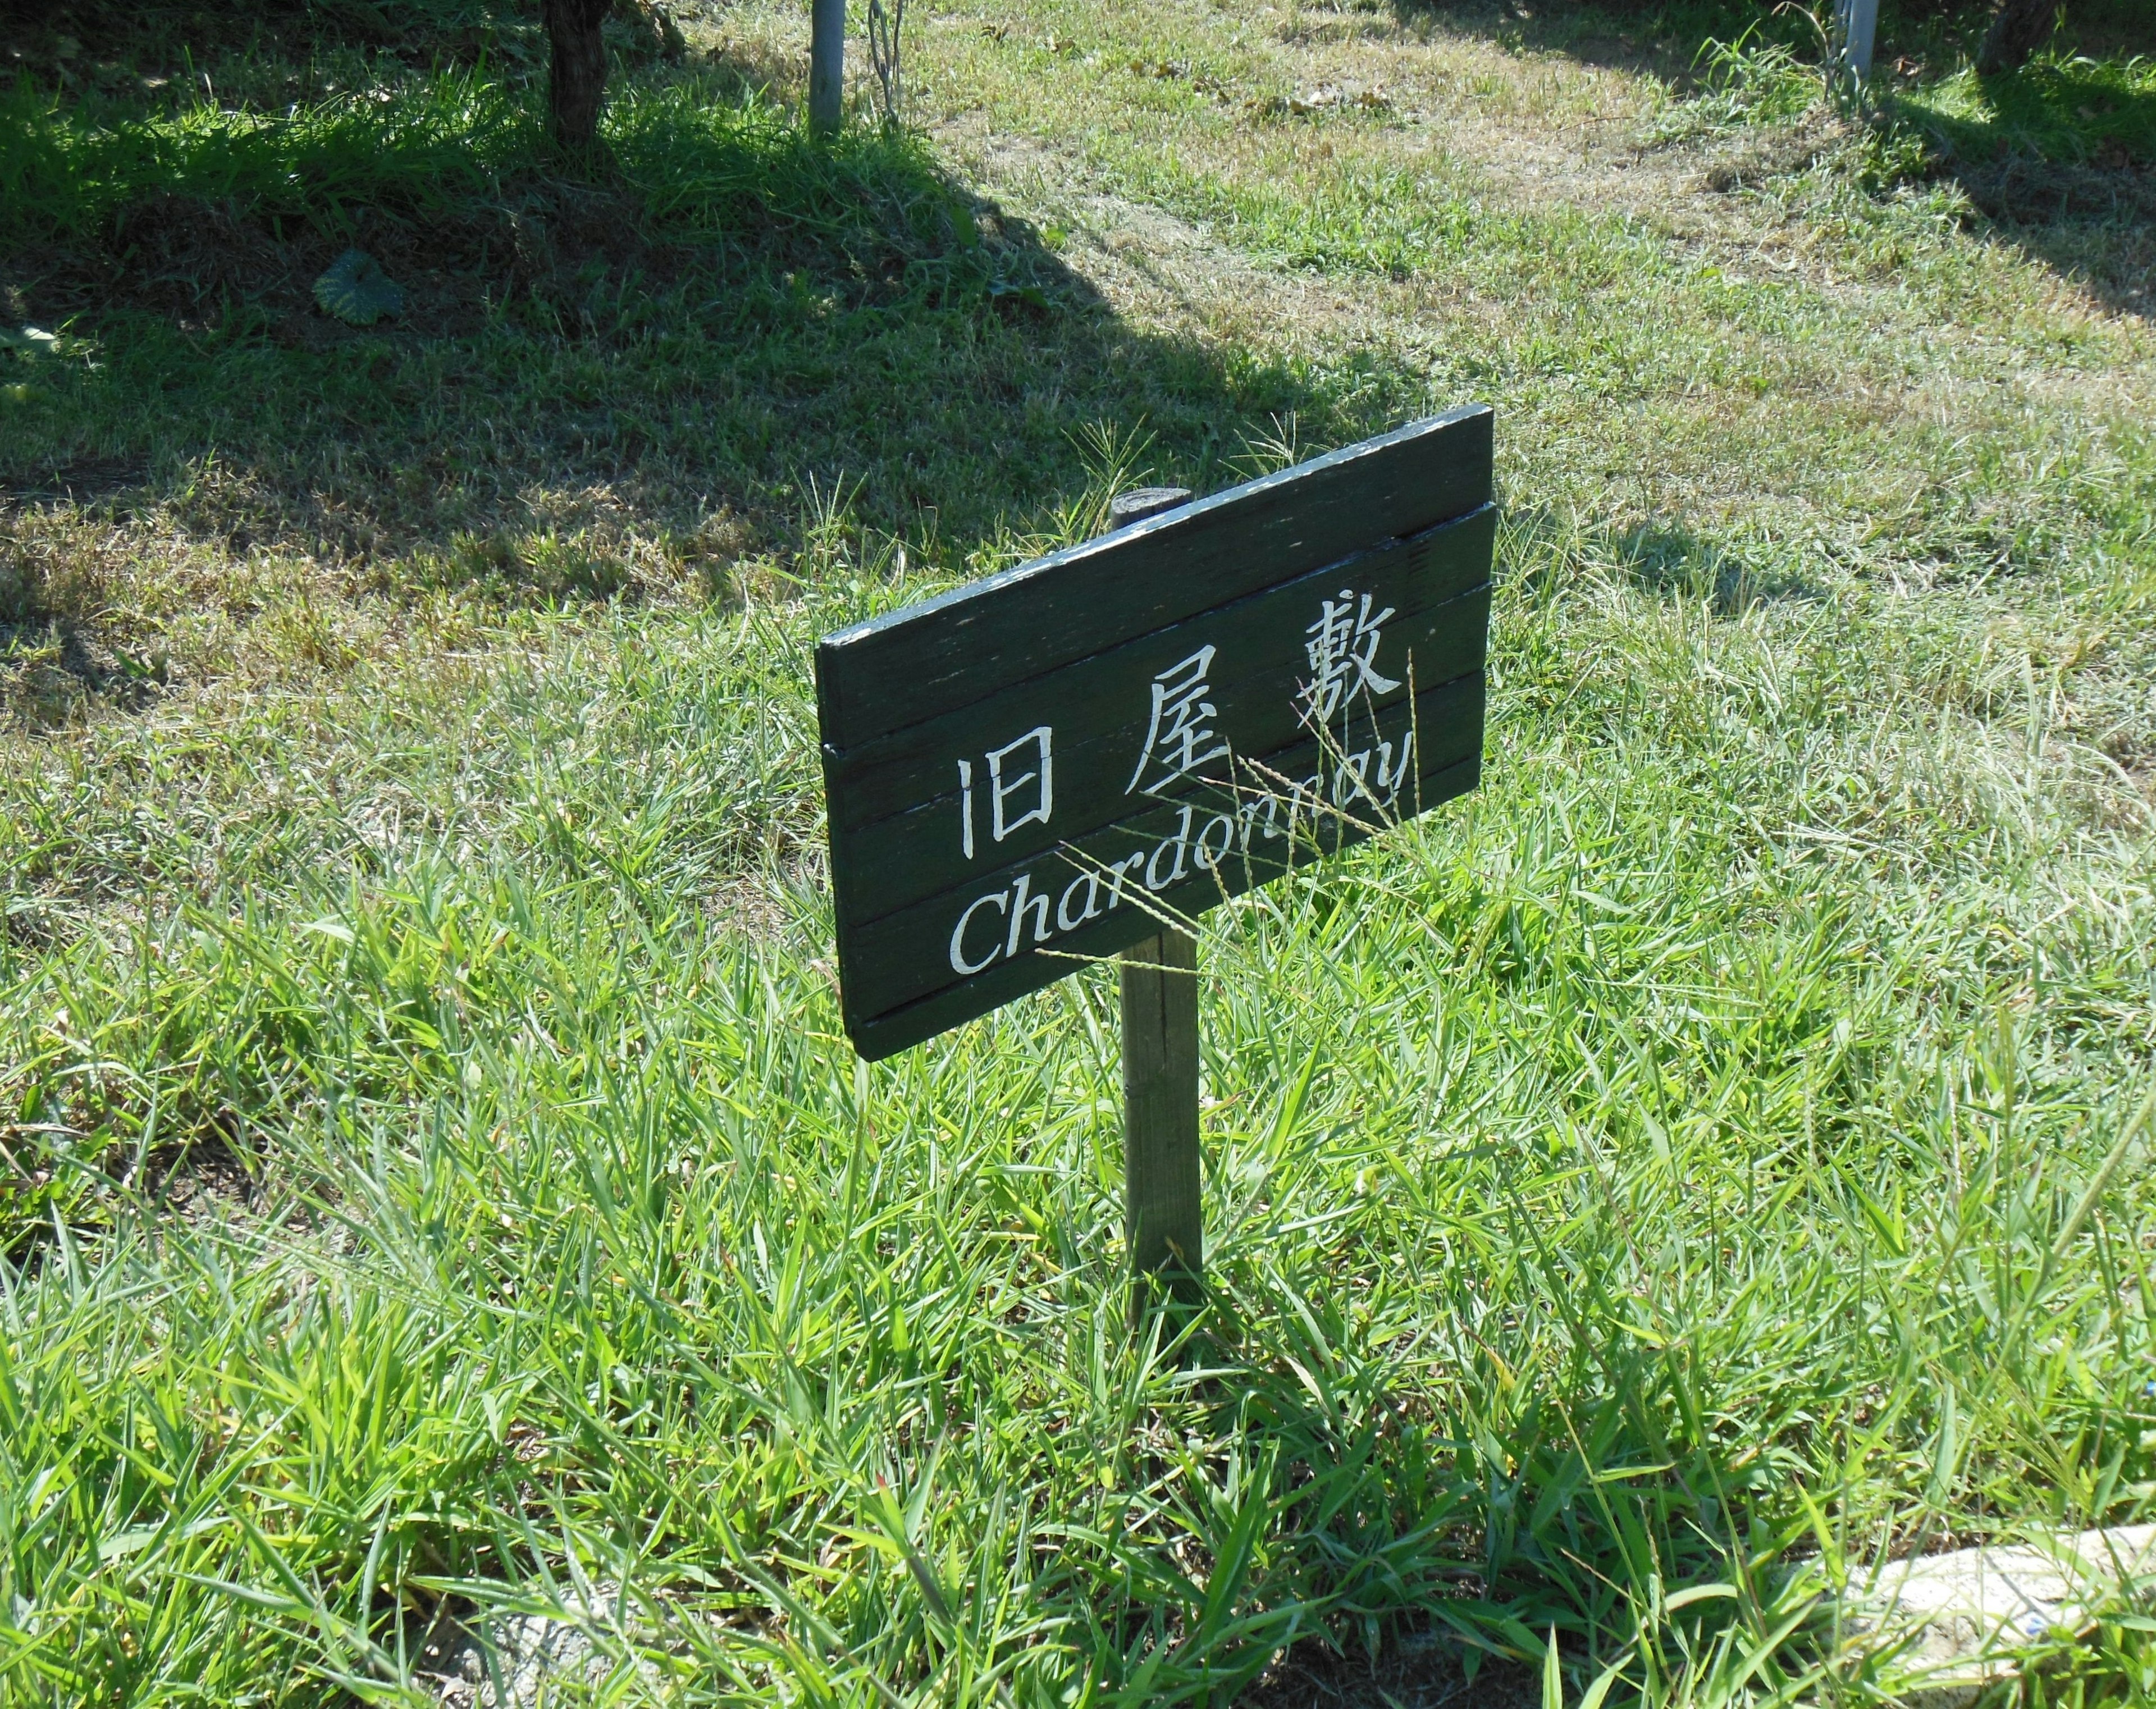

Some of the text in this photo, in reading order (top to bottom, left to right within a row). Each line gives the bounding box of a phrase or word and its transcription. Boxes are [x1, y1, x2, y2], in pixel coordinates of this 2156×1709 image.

[949, 731, 1412, 974] Chardonnay
[958, 590, 1402, 859] 旧屋敷
